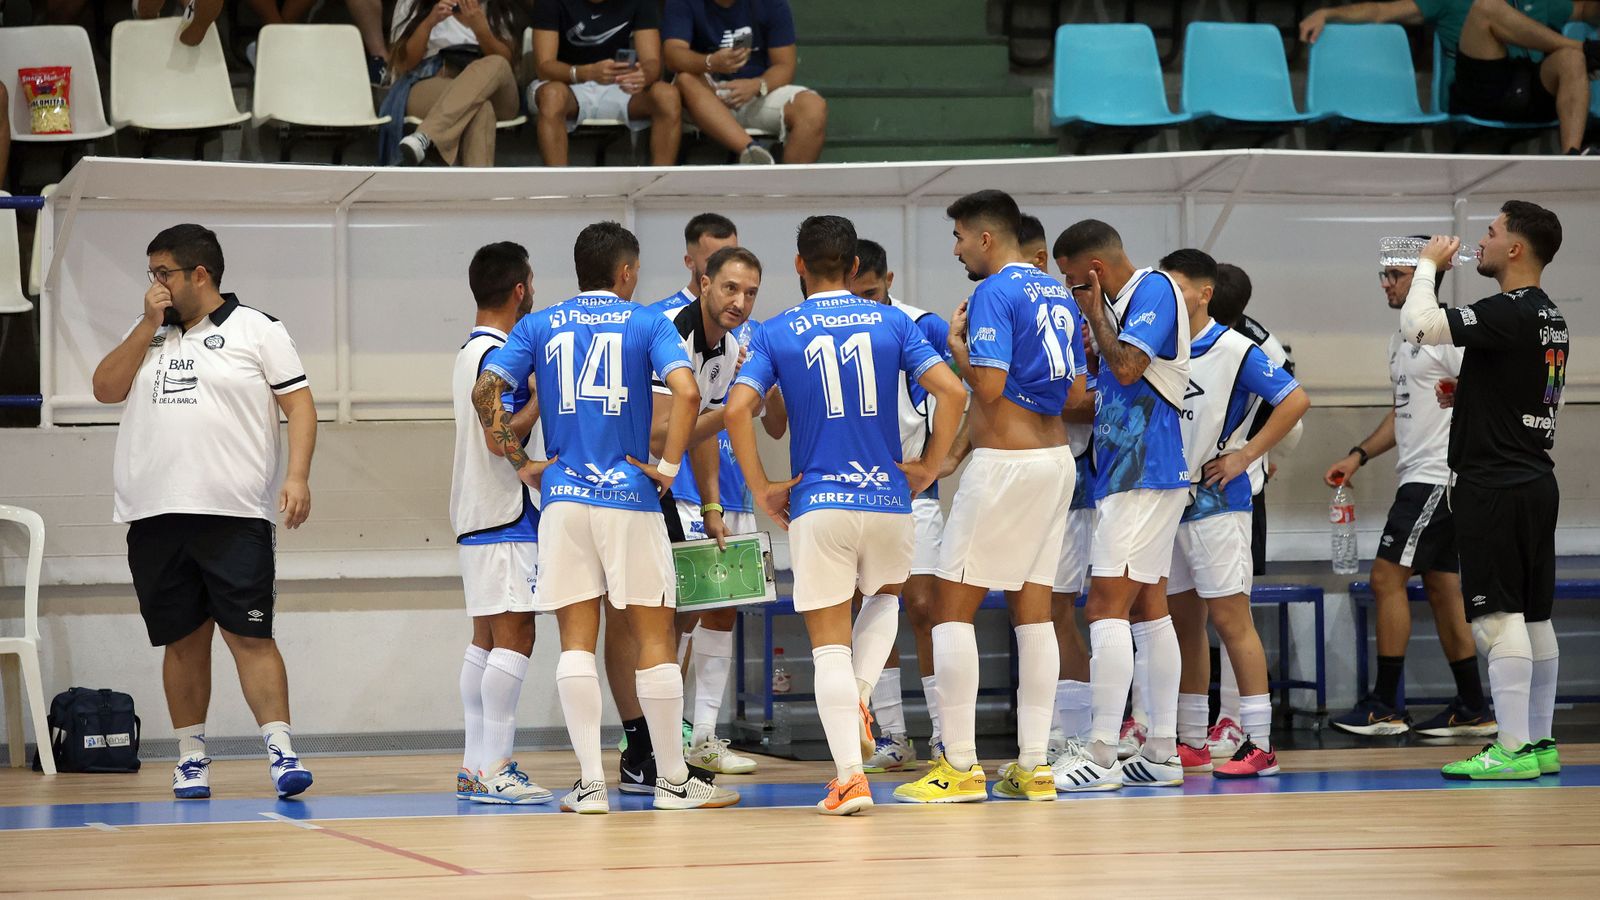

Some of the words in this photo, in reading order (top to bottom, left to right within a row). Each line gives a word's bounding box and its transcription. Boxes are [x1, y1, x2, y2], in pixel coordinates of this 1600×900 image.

[168, 358, 195, 371] BAR
[545, 331, 629, 416] 14
[804, 331, 878, 418] 11
[549, 484, 591, 498] XEREZ
[593, 488, 643, 503] FUTSAL
[809, 491, 855, 505] XEREZ
[858, 493, 904, 507] FUTSAL
